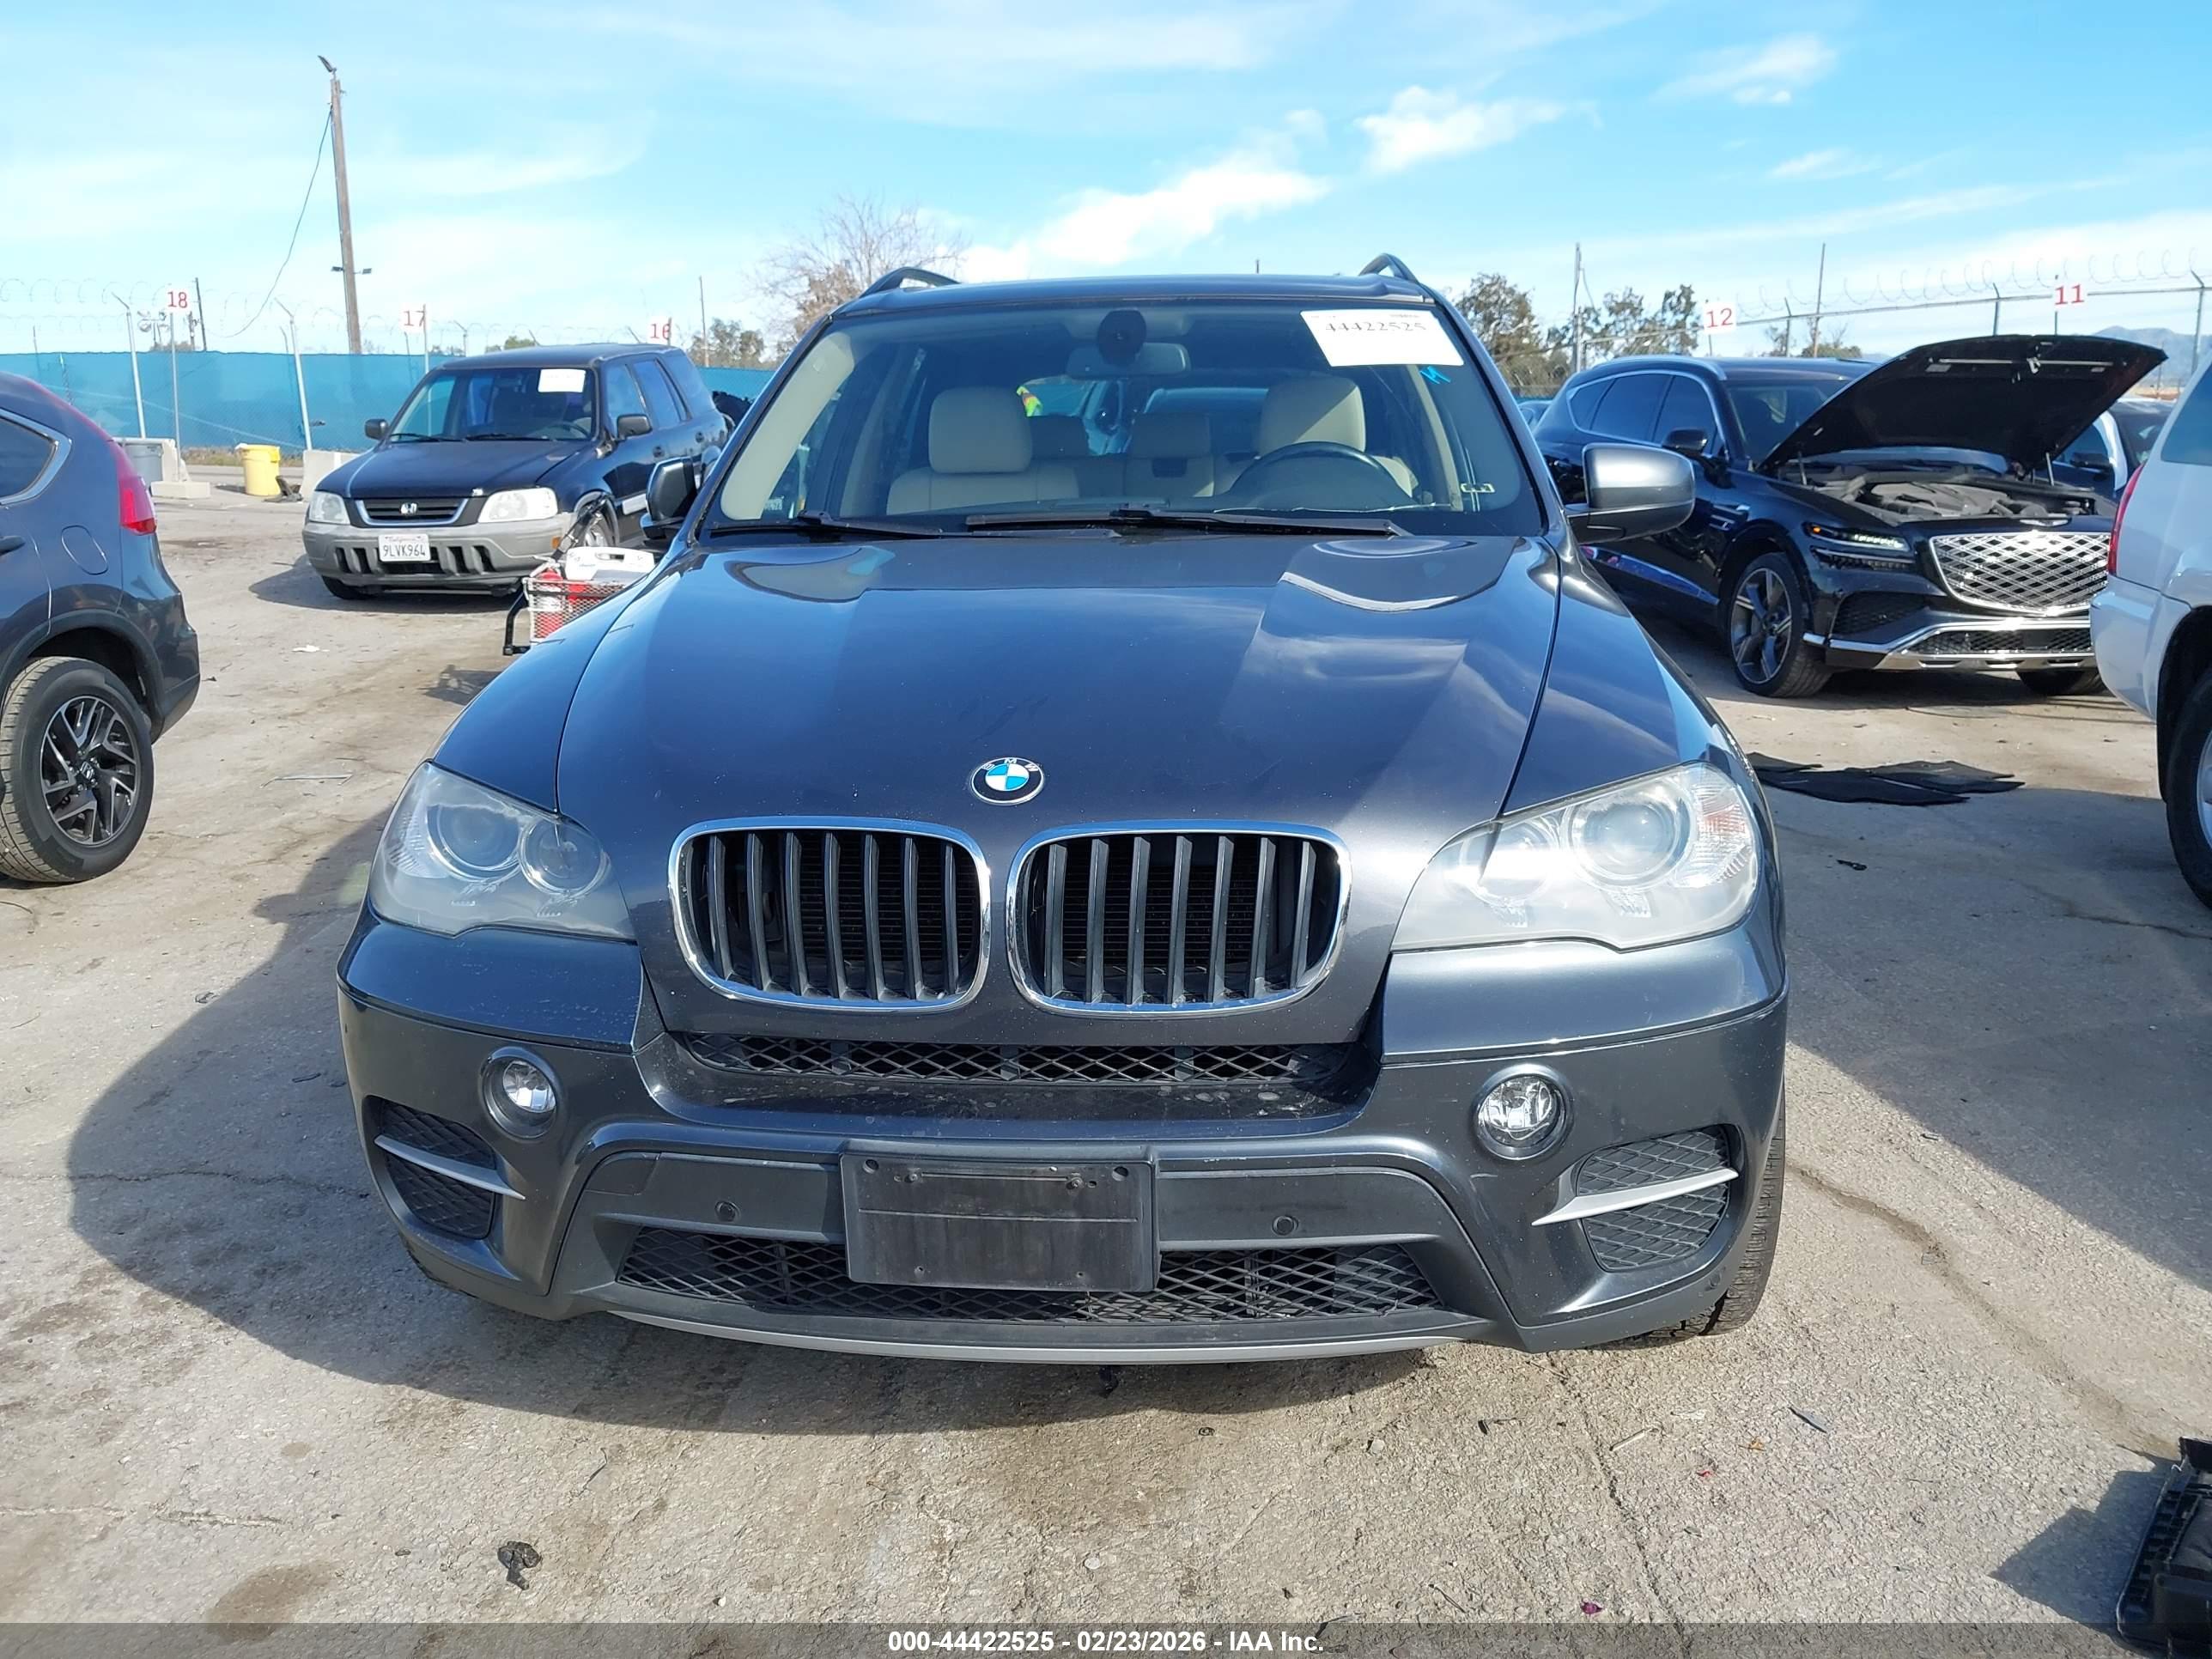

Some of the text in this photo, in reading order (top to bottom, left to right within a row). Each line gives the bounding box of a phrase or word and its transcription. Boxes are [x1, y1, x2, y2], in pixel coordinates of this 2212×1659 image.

[167, 290, 188, 309] 18
[2054, 283, 2086, 305] 11
[402, 310, 425, 328] 17
[1706, 307, 1734, 328] 12
[1325, 321, 1427, 333] 44422525
[981, 757, 1039, 772] BMW
